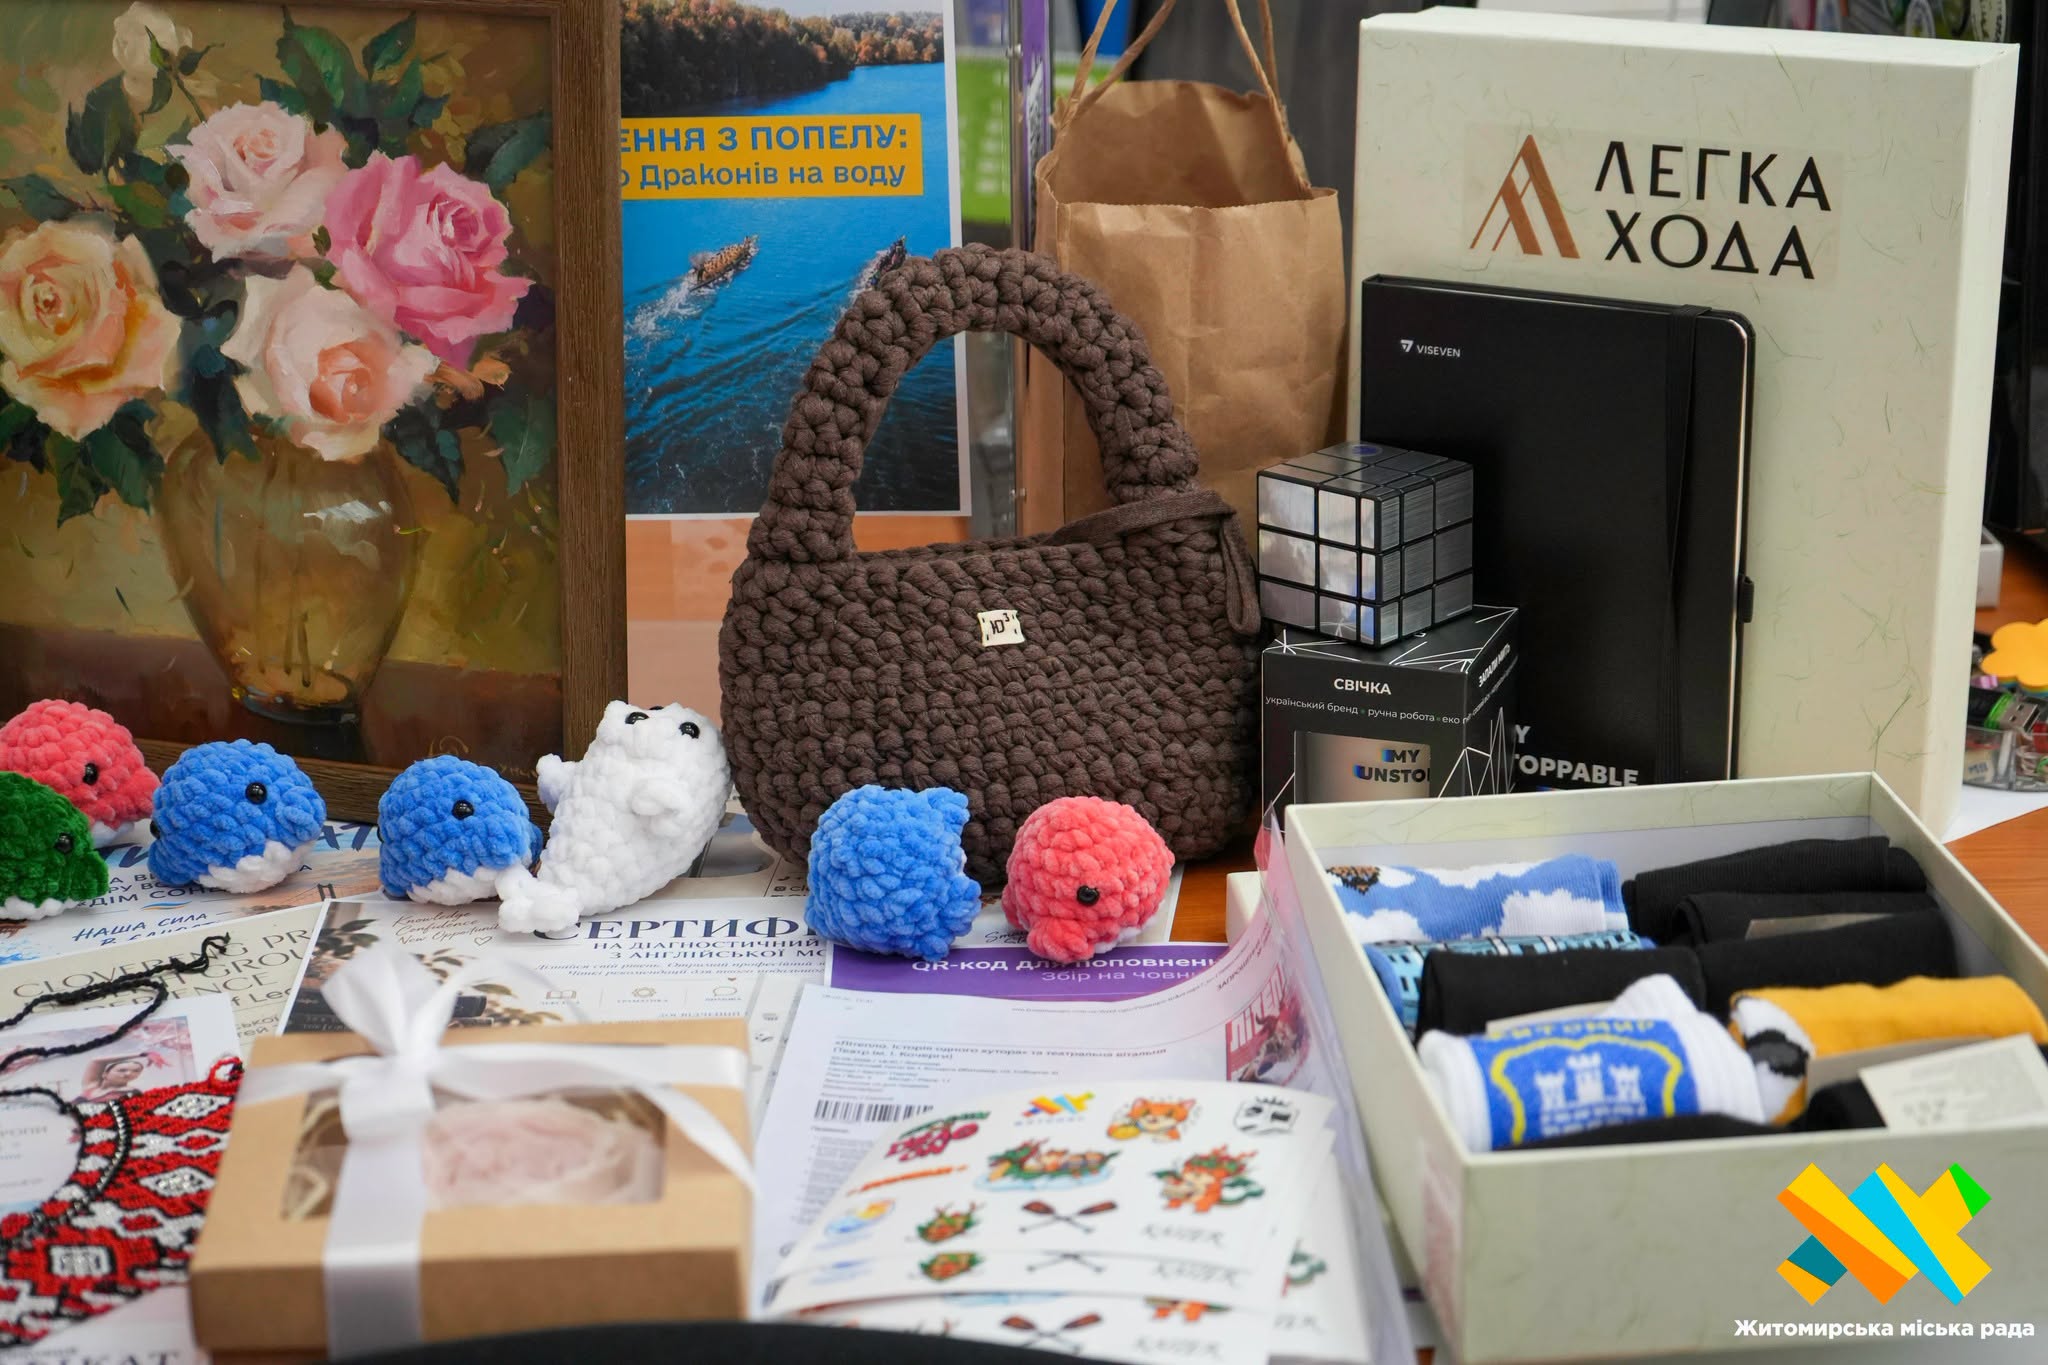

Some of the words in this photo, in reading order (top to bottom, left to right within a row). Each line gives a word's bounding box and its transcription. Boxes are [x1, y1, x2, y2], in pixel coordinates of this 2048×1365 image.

[751, 124, 907, 150] ПОПЕЛУ:
[640, 162, 779, 190] Драконів
[789, 166, 824, 184] на
[834, 165, 905, 188] воду
[1594, 140, 1832, 212] ЛЕГКА
[1605, 208, 1816, 280] ХОДА
[1415, 344, 1461, 359] VISEVEN
[1333, 678, 1392, 695] СВІЧКА
[1265, 696, 1325, 711] український
[1327, 702, 1359, 715] бренд
[1368, 708, 1398, 719] ручна
[1399, 710, 1435, 723] робота
[1442, 716, 1460, 725] еко
[1387, 749, 1420, 763] MY
[1357, 765, 1430, 783] UNSTO
[1515, 753, 1639, 786] OPPABLE
[72, 921, 146, 942] НАША
[158, 913, 208, 927] СИЛА
[630, 939, 820, 950] ДІАГНОСТИЧНИЙ
[911, 960, 1008, 972] QR-код
[1042, 971, 1091, 982] Збір
[1098, 972, 1123, 981] на
